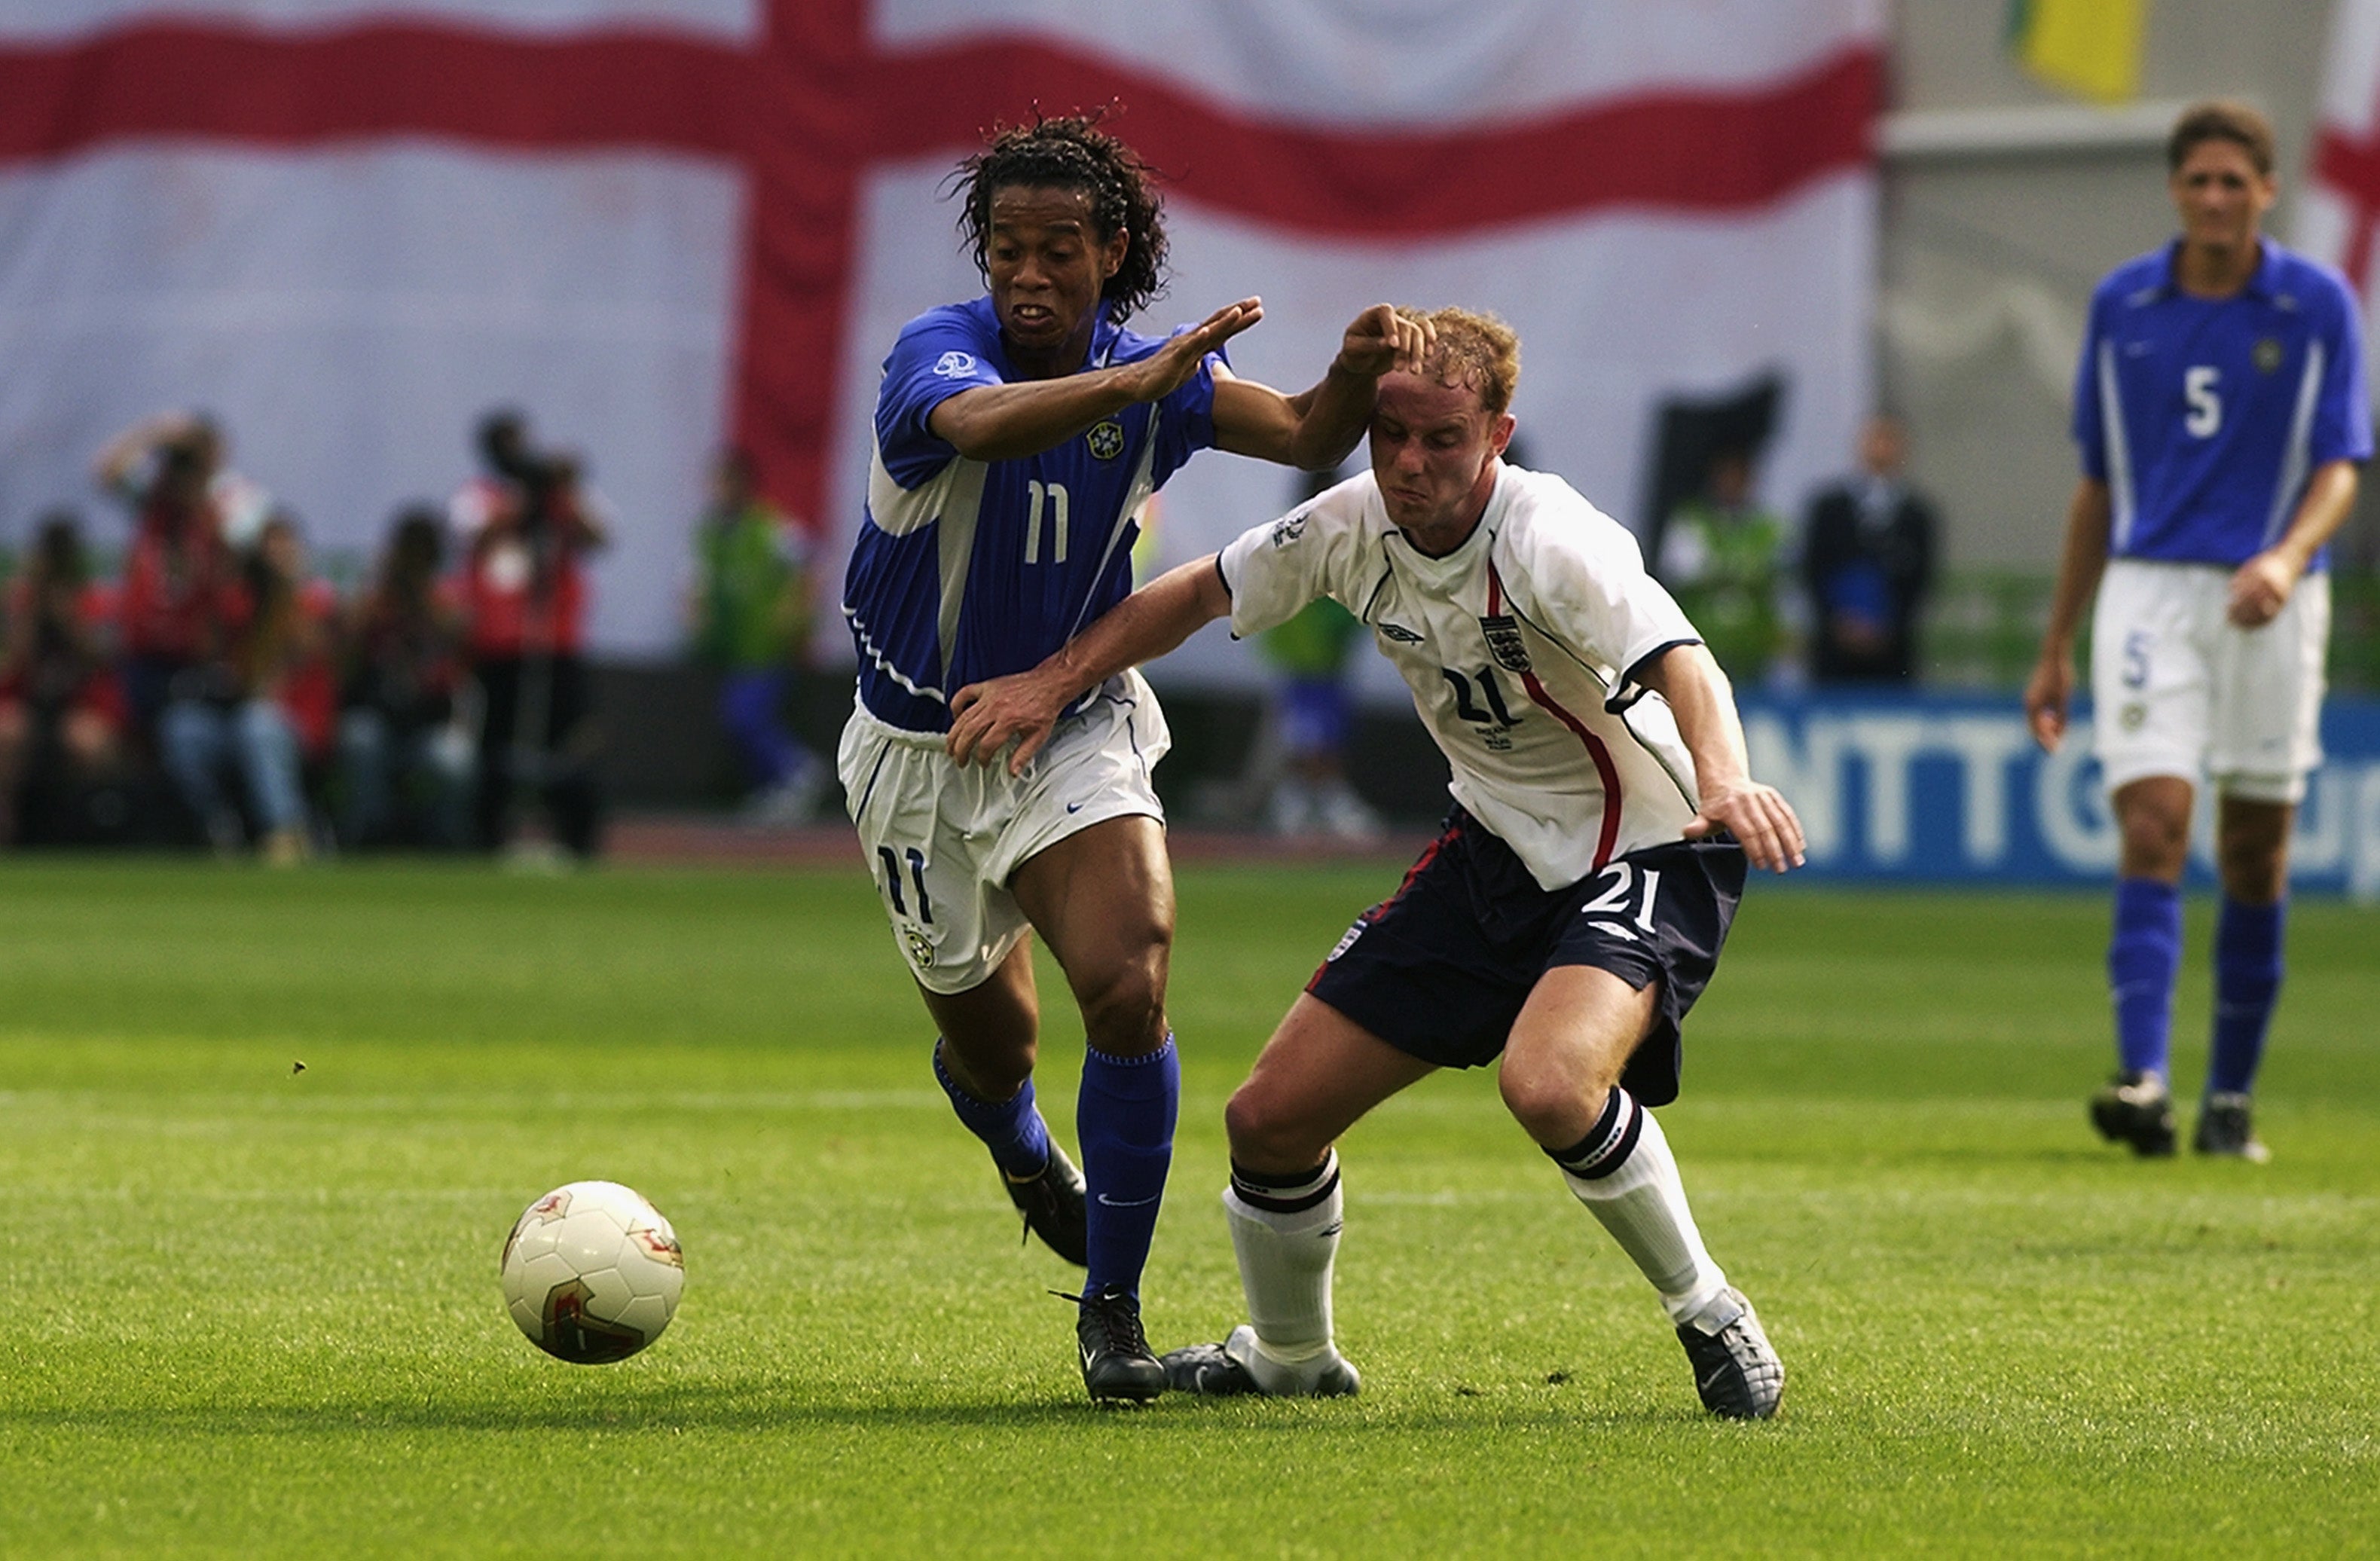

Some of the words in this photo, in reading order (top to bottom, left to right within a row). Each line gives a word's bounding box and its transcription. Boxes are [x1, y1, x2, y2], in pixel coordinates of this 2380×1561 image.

[2184, 366, 2221, 438] 5
[1025, 480, 1068, 564] 11
[1441, 664, 1523, 727] 21
[2122, 631, 2153, 690] 5
[878, 845, 933, 924] 11
[1581, 861, 1660, 933] 21
